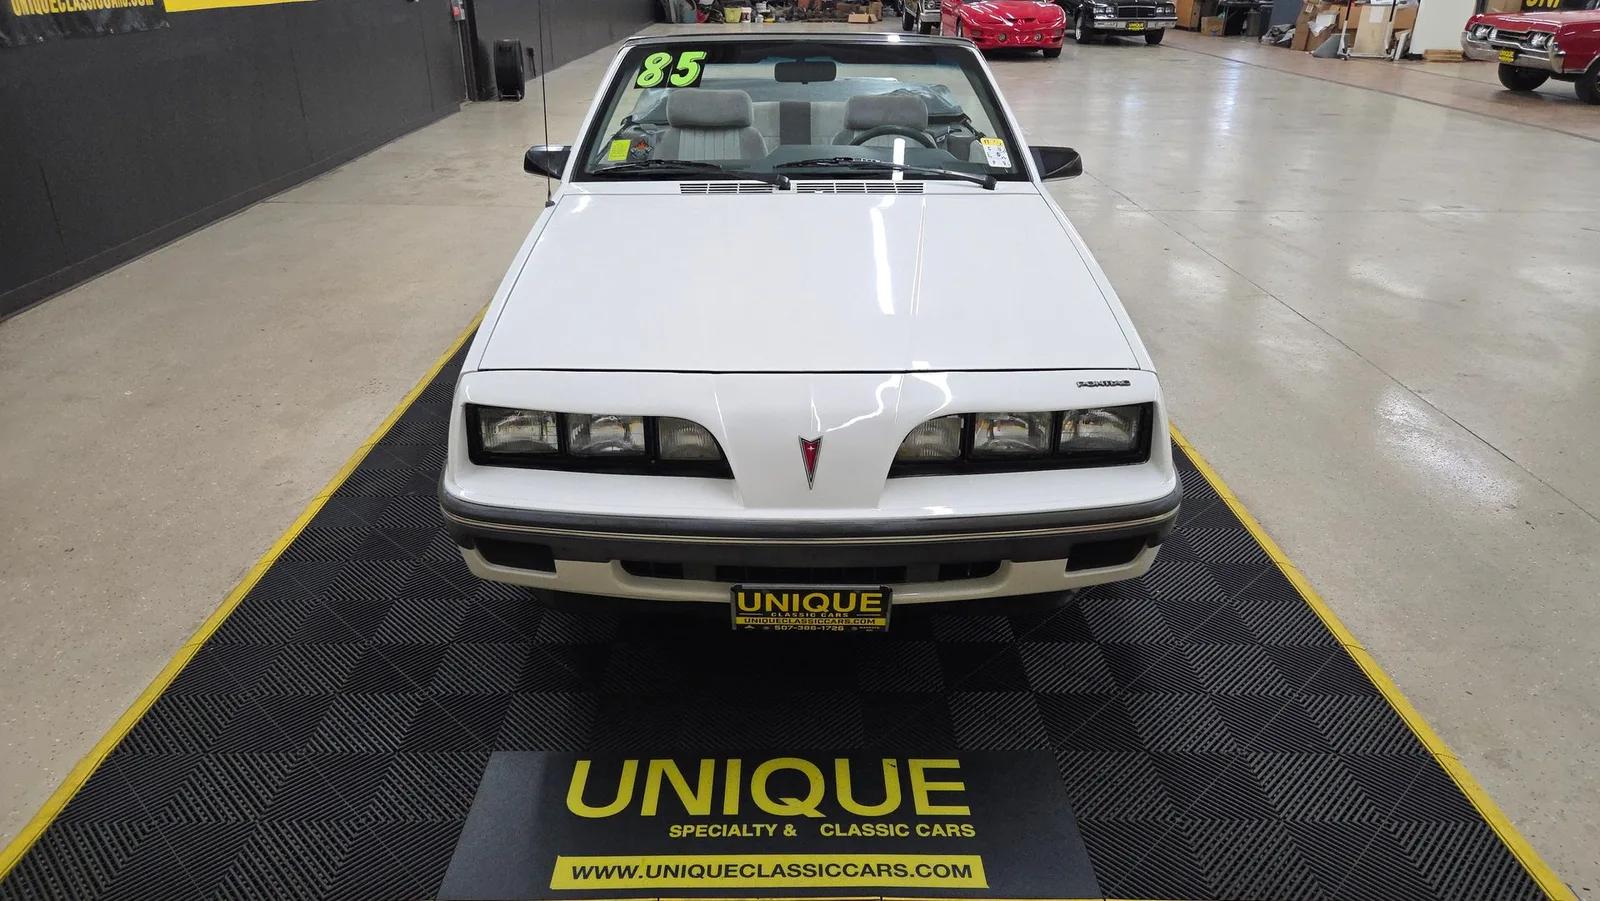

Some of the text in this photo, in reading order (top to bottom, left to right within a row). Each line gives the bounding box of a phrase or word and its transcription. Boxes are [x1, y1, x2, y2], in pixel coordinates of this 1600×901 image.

[636, 51, 707, 87] 85
[737, 592, 882, 613] UNIQUE
[566, 757, 971, 818] UNIQUE
[669, 823, 976, 838] SPECIALTY & CLASSIC CARS
[571, 863, 973, 880] WWW.UNIQUECLASSICCARS.COM
